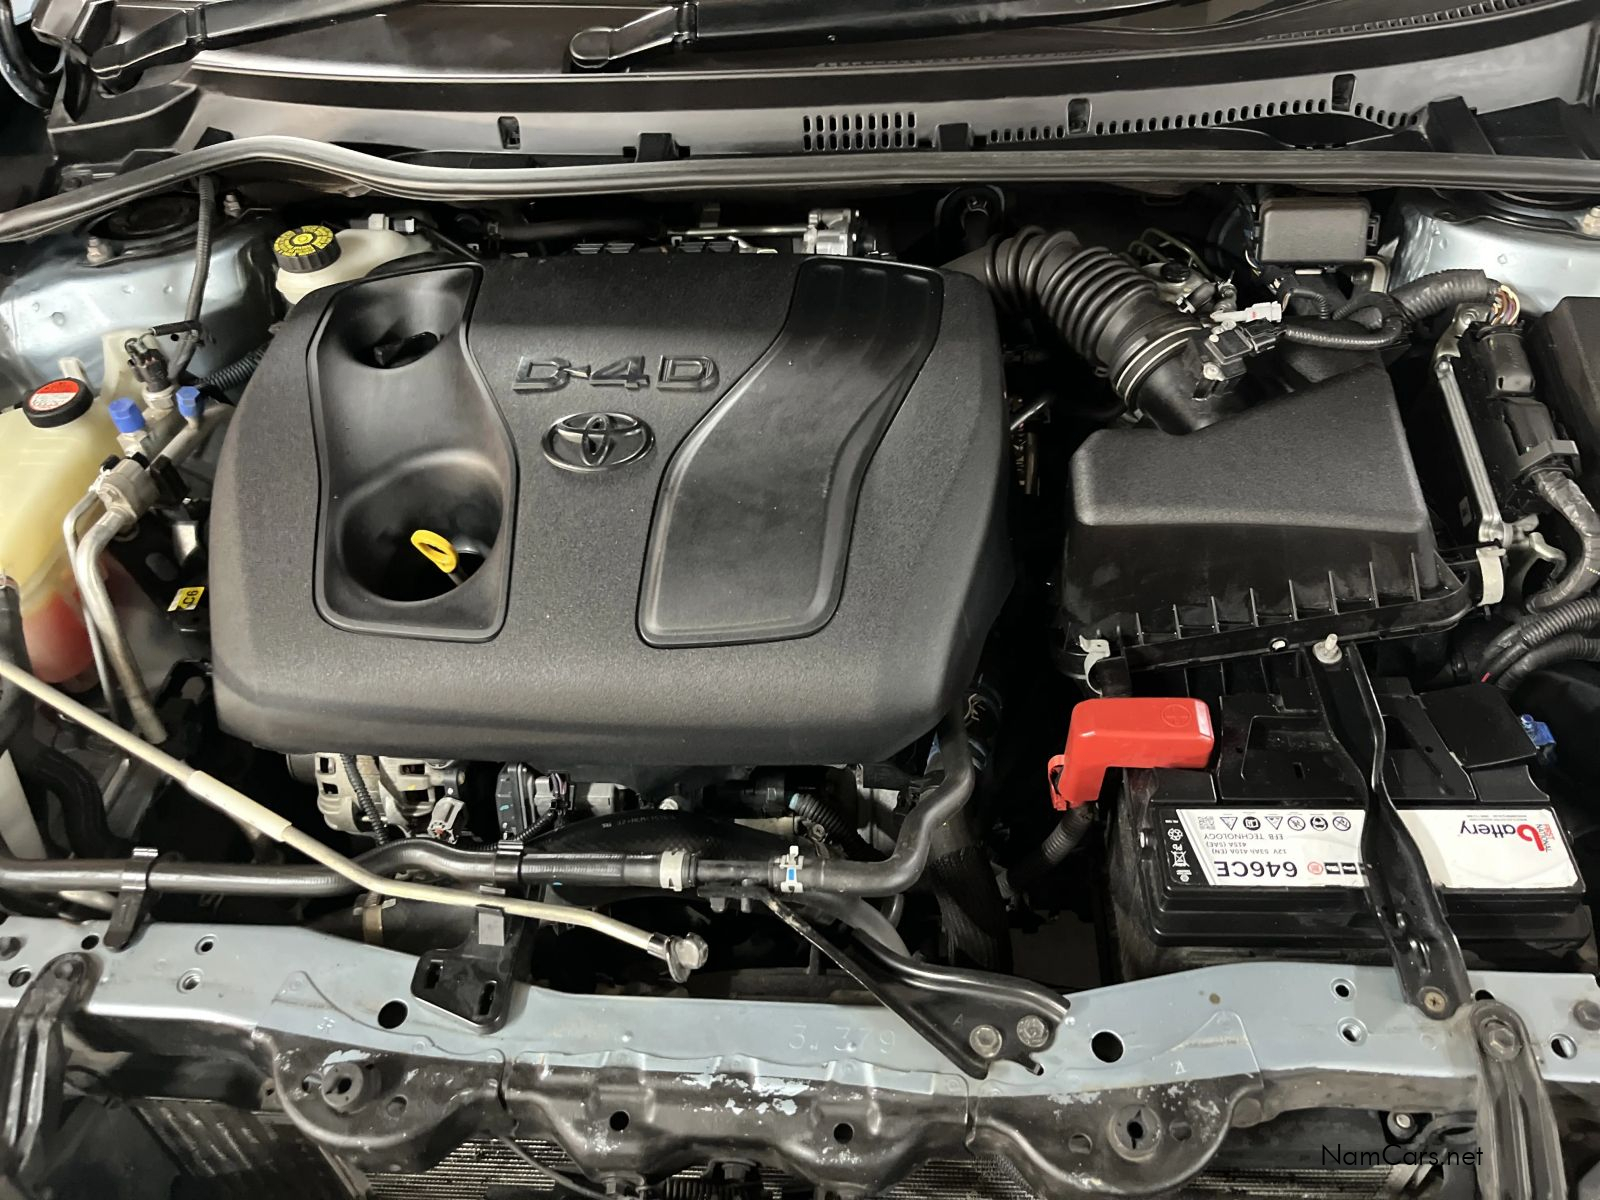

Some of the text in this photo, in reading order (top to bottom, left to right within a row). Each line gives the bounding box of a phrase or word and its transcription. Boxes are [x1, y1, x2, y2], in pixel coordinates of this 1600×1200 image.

[511, 354, 721, 394] D-4D
[1203, 833, 1264, 841] TECHNOLOGY
[1459, 820, 1547, 852] battery
[1213, 860, 1298, 878] 646CE
